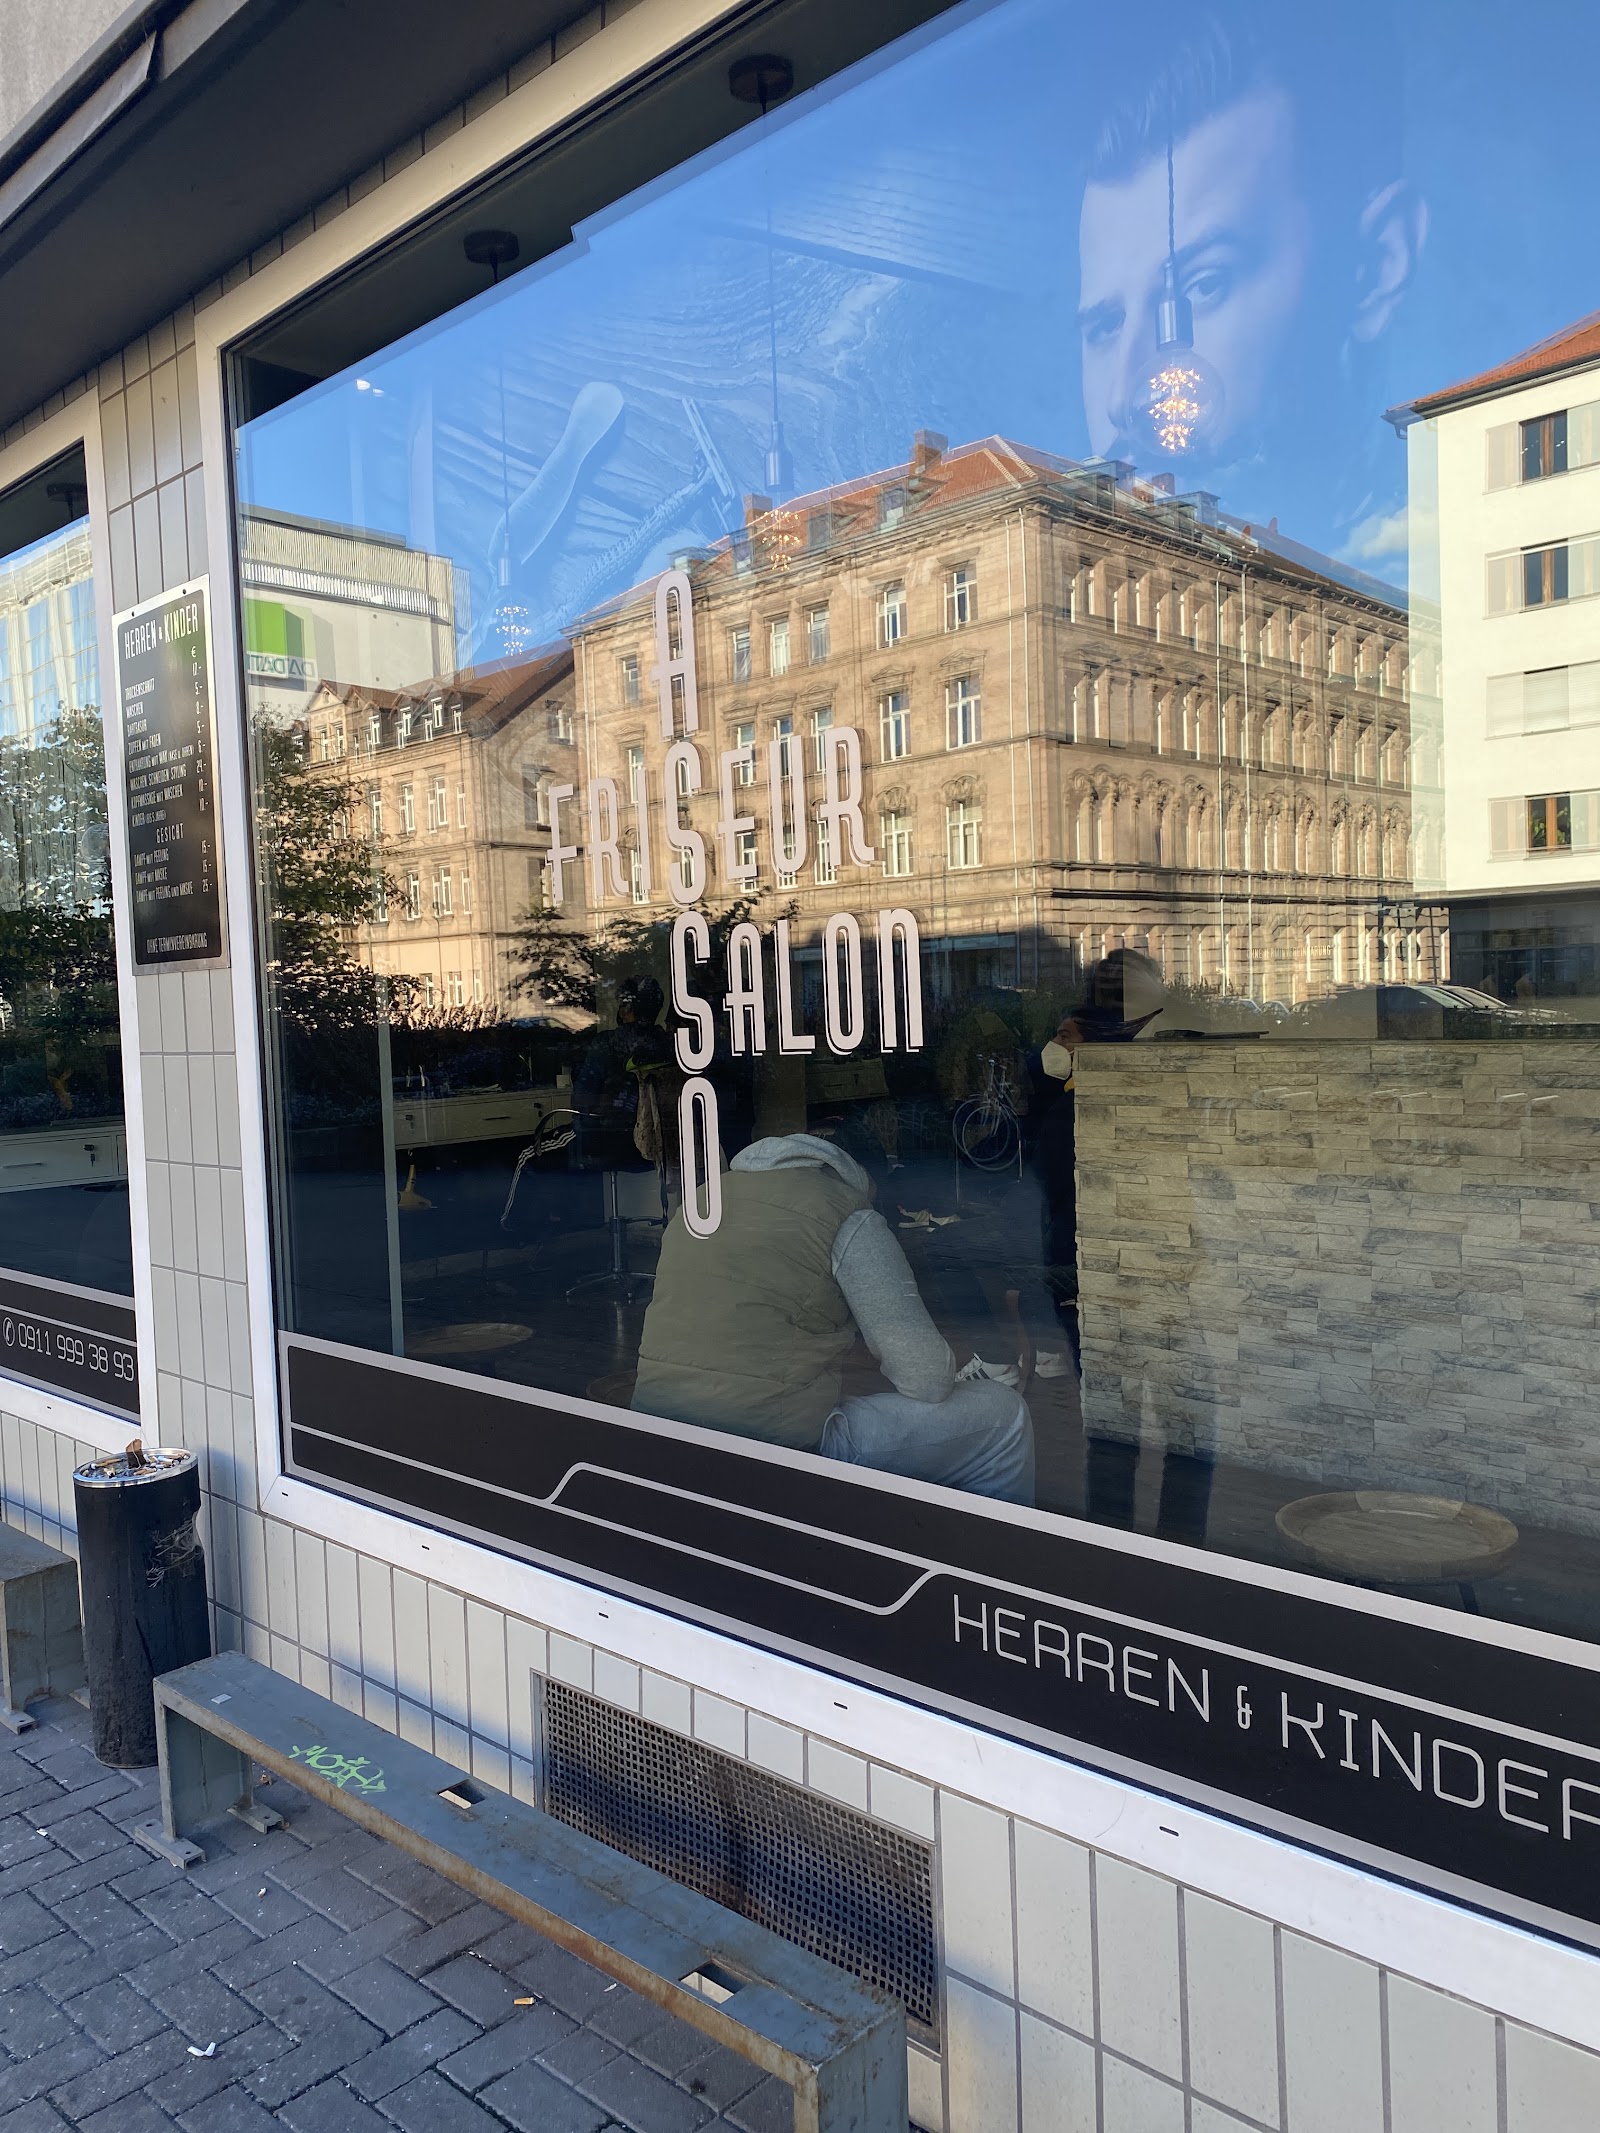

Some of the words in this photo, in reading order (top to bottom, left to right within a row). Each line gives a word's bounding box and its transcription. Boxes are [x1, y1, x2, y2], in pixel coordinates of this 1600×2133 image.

[124, 620, 157, 660] HERREN
[158, 627, 162, 640] &
[164, 602, 198, 644] KINDER
[191, 646, 196, 658] €
[126, 702, 143, 718] WASCHEN
[164, 785, 183, 800] WASCHEN
[547, 725, 875, 900] FRISEUR
[156, 824, 184, 843] GESICHT
[146, 939, 157, 953] OHNE
[158, 933, 207, 952] TERMINVEREINBARUNG
[669, 908, 924, 1075] SALON
[18, 1323, 51, 1356] 0911
[57, 1334, 84, 1365] 999
[88, 1343, 109, 1373] 38
[113, 1351, 135, 1382] 93
[953, 1593, 1211, 1723] HERREN
[1236, 1685, 1253, 1729] &
